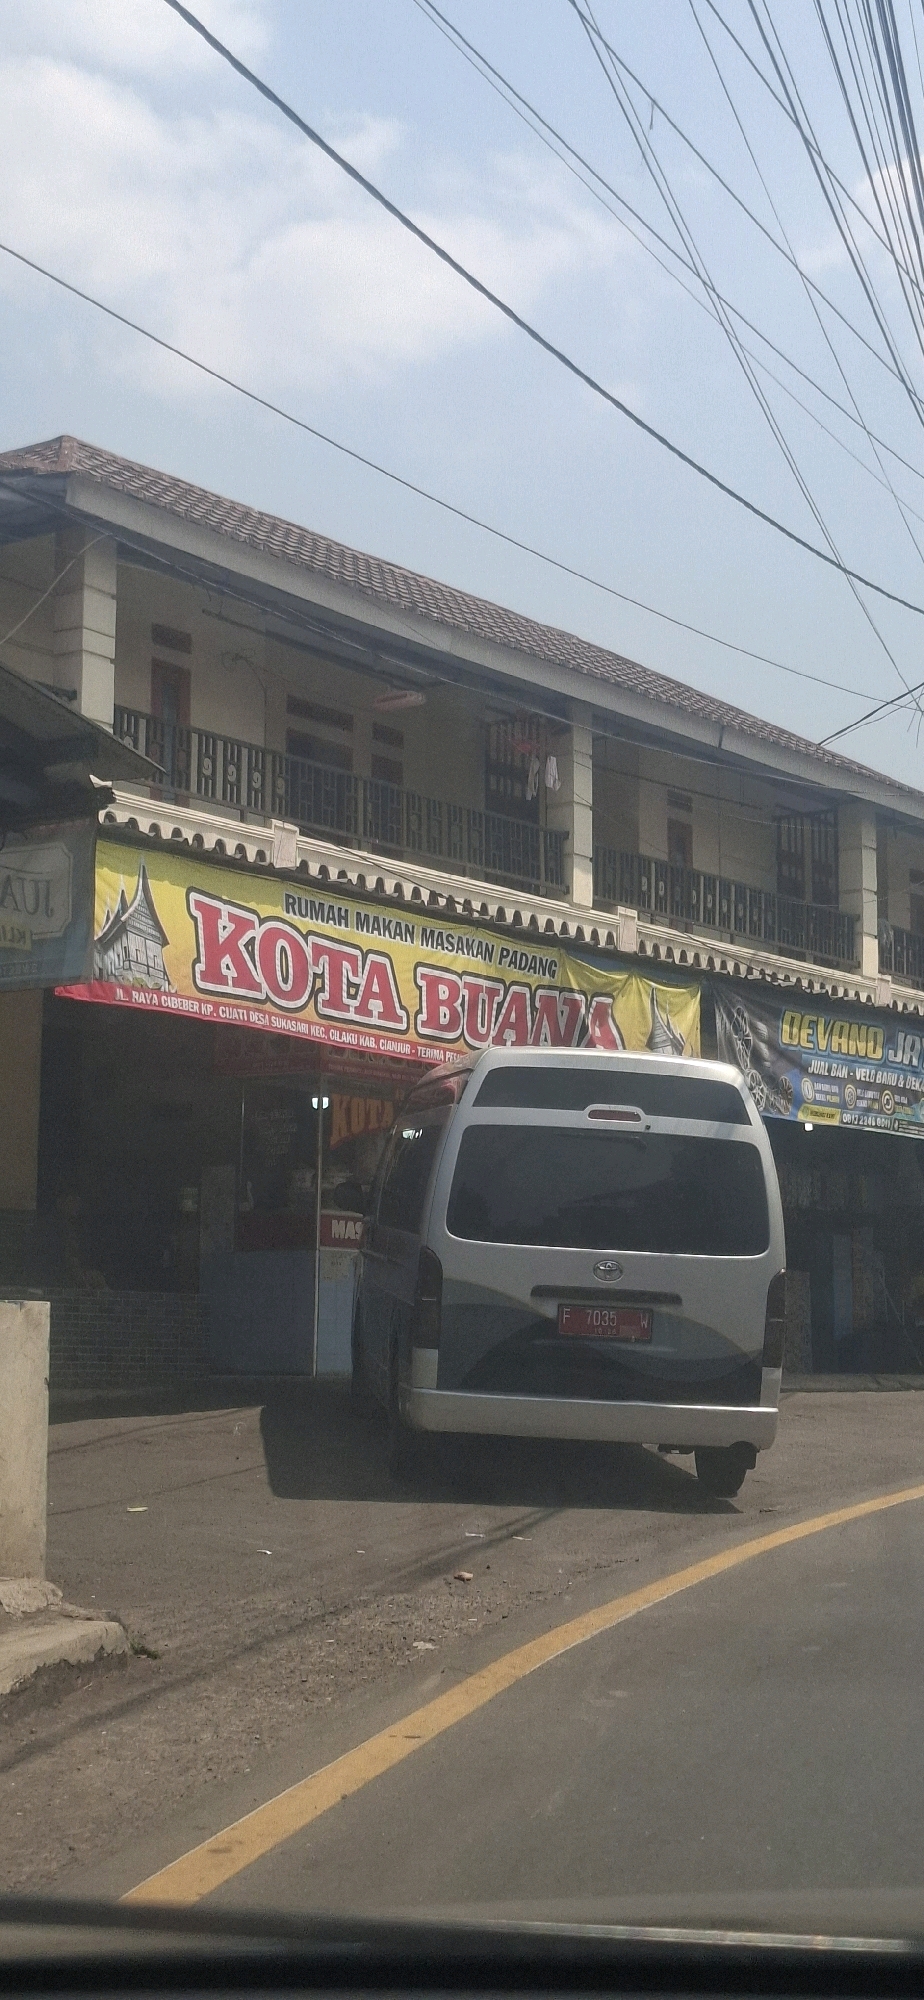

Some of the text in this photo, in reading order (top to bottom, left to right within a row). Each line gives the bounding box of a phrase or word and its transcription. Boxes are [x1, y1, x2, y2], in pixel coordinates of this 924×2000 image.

[284, 893, 558, 979] RUMAH MAKAN MASAKAN PADANG
[187, 889, 626, 1050] KOTA BUANA
[132, 990, 158, 1005] RAYA
[161, 995, 200, 1014] CIBEBER
[201, 1003, 217, 1017] KP.
[219, 1007, 247, 1021] CIJATI
[250, 1011, 269, 1026] DESA
[271, 1016, 309, 1035] SUKASARI
[330, 1029, 358, 1045] CILAKU
[359, 1035, 377, 1049] KAB.
[379, 1041, 411, 1055] CIANJUR
[417, 1046, 445, 1062] TERIMA
[782, 1010, 924, 1067] DEVANO JA
[808, 1060, 829, 1076] JUAL
[831, 1063, 848, 1079] BAN
[876, 1071, 897, 1087] BARU
[898, 1075, 904, 1088] &
[563, 1308, 649, 1329] F 7035 W
